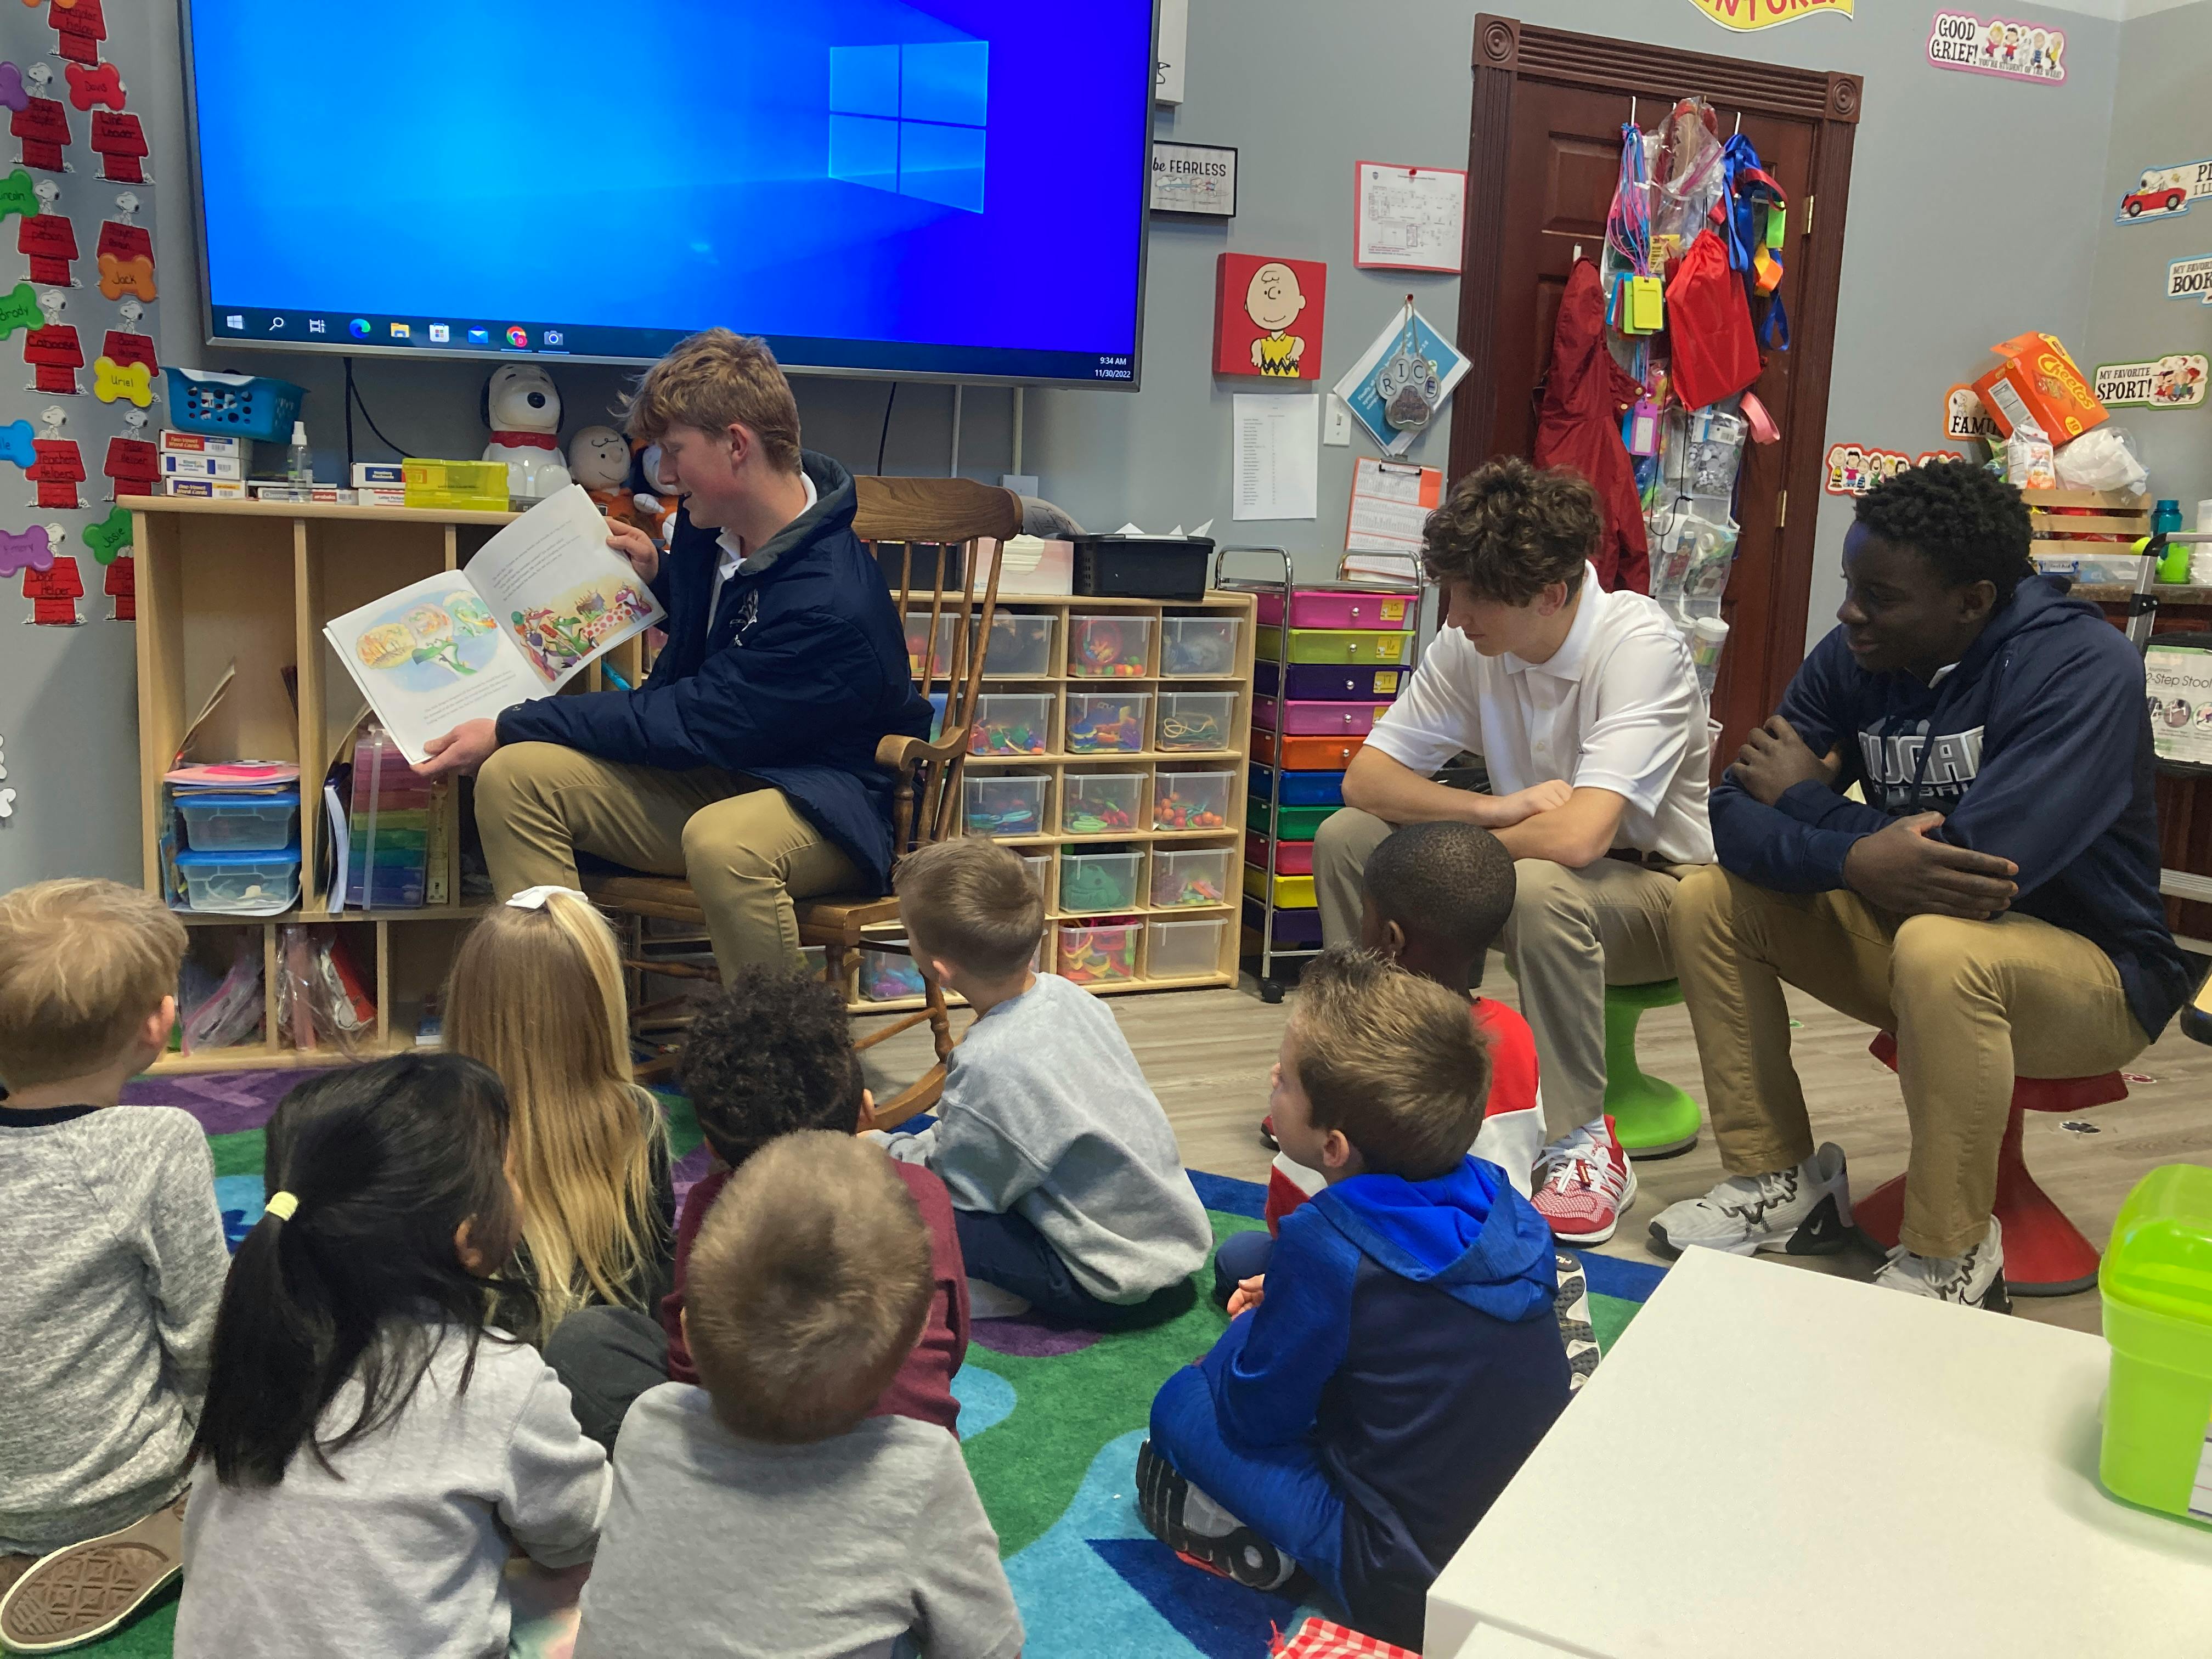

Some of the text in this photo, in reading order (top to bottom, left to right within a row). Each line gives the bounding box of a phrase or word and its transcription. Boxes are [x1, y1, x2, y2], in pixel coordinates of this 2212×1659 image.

[1939, 18, 1976, 41] GOOD
[1932, 39, 1978, 65] GRIEF!
[1999, 61, 2023, 73] STUDENT
[2032, 66, 2044, 76] THE
[1153, 157, 1226, 177] be FEARLESS
[2173, 265, 2186, 274] MY
[111, 272, 137, 285] Jack
[0, 304, 28, 321] Brody
[1100, 357, 1126, 365] 9:34 AM
[1095, 369, 1131, 378] 11/30/2022
[2099, 367, 2151, 380] MY FAVORITE
[111, 375, 133, 388] Uriel
[2039, 354, 2095, 409] Cheetos
[1403, 388, 1419, 398] The
[2097, 379, 2152, 400] SPORT!
[1395, 399, 1424, 410] Cougar
[2067, 420, 2080, 431] 10
[103, 526, 125, 549] Josie
[1390, 603, 1399, 612] 15
[1387, 640, 1395, 651] 16
[1383, 674, 1392, 685] 17
[2182, 675, 2212, 689] Stool
